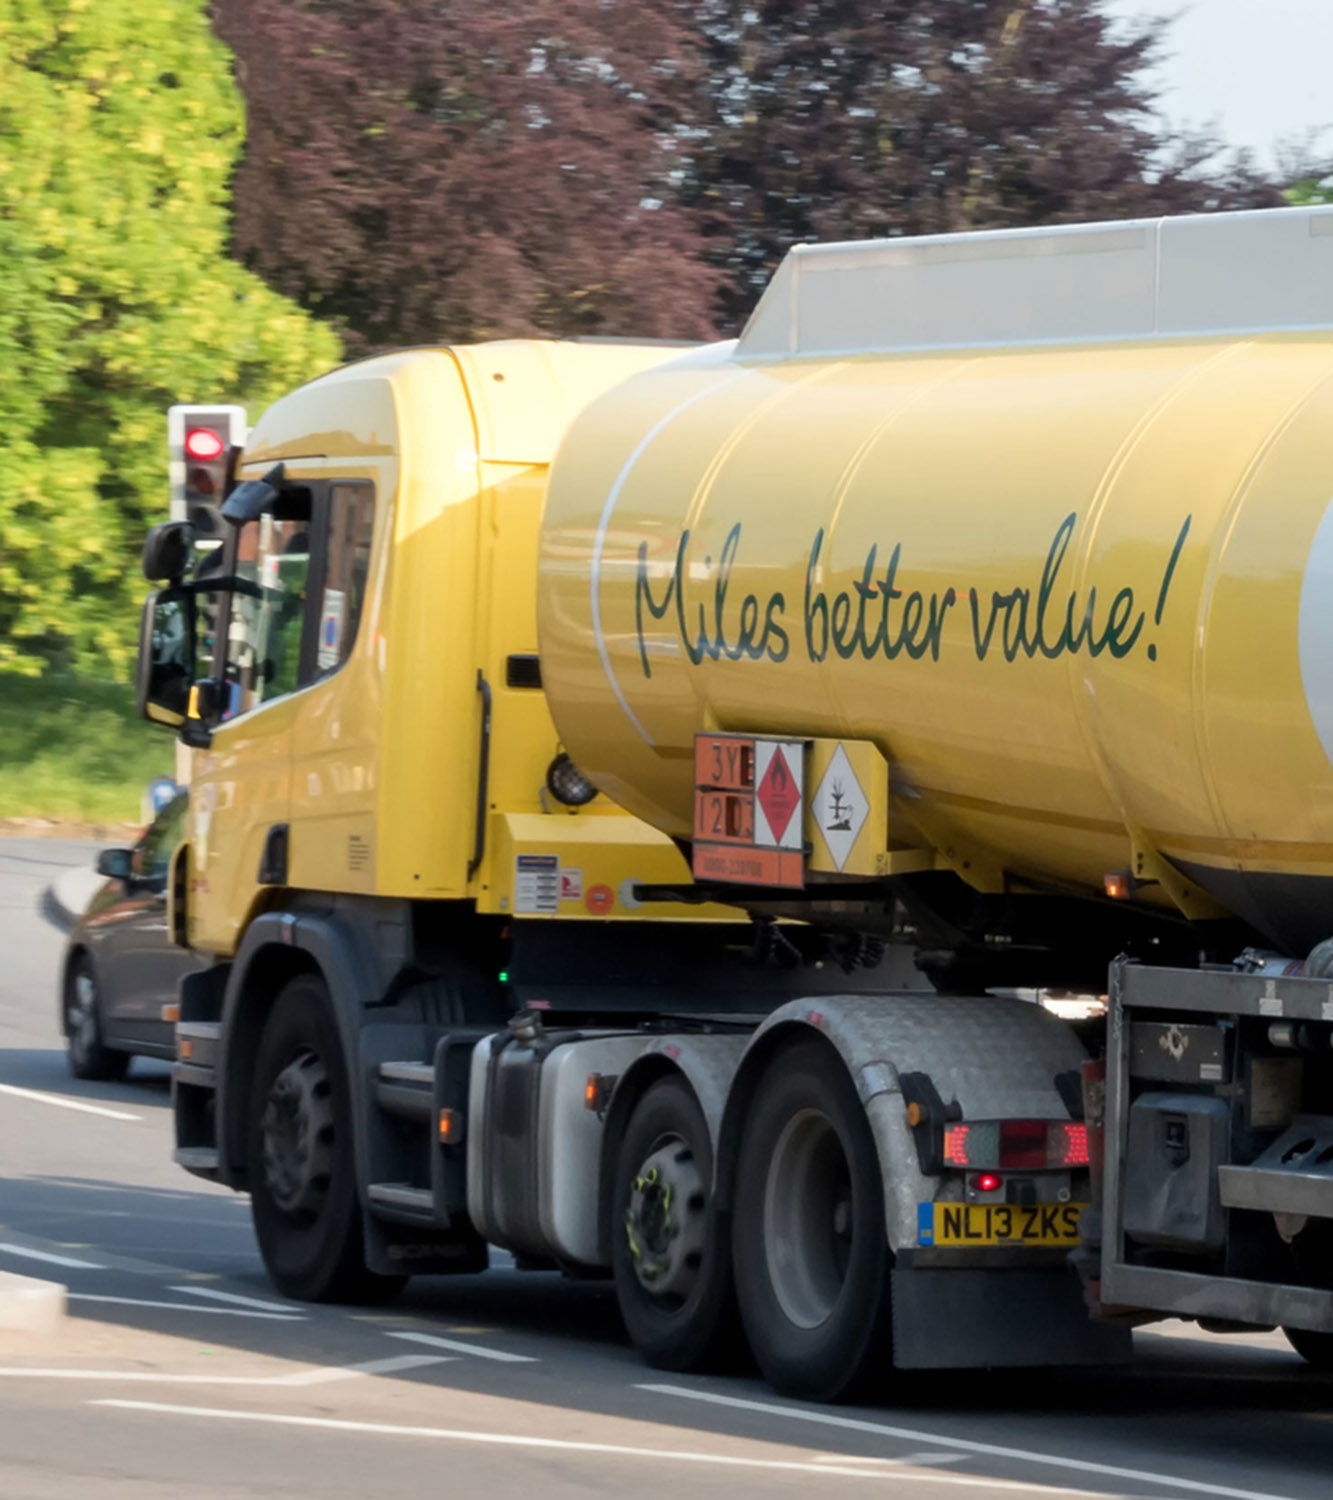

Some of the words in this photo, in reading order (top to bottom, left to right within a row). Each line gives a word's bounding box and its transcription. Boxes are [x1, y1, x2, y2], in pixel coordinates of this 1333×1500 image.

[635, 521, 789, 679] Miles
[804, 527, 956, 663] better
[968, 511, 1192, 663] value!
[943, 1207, 1013, 1239] NL13
[1021, 1207, 1080, 1239] ZKS
